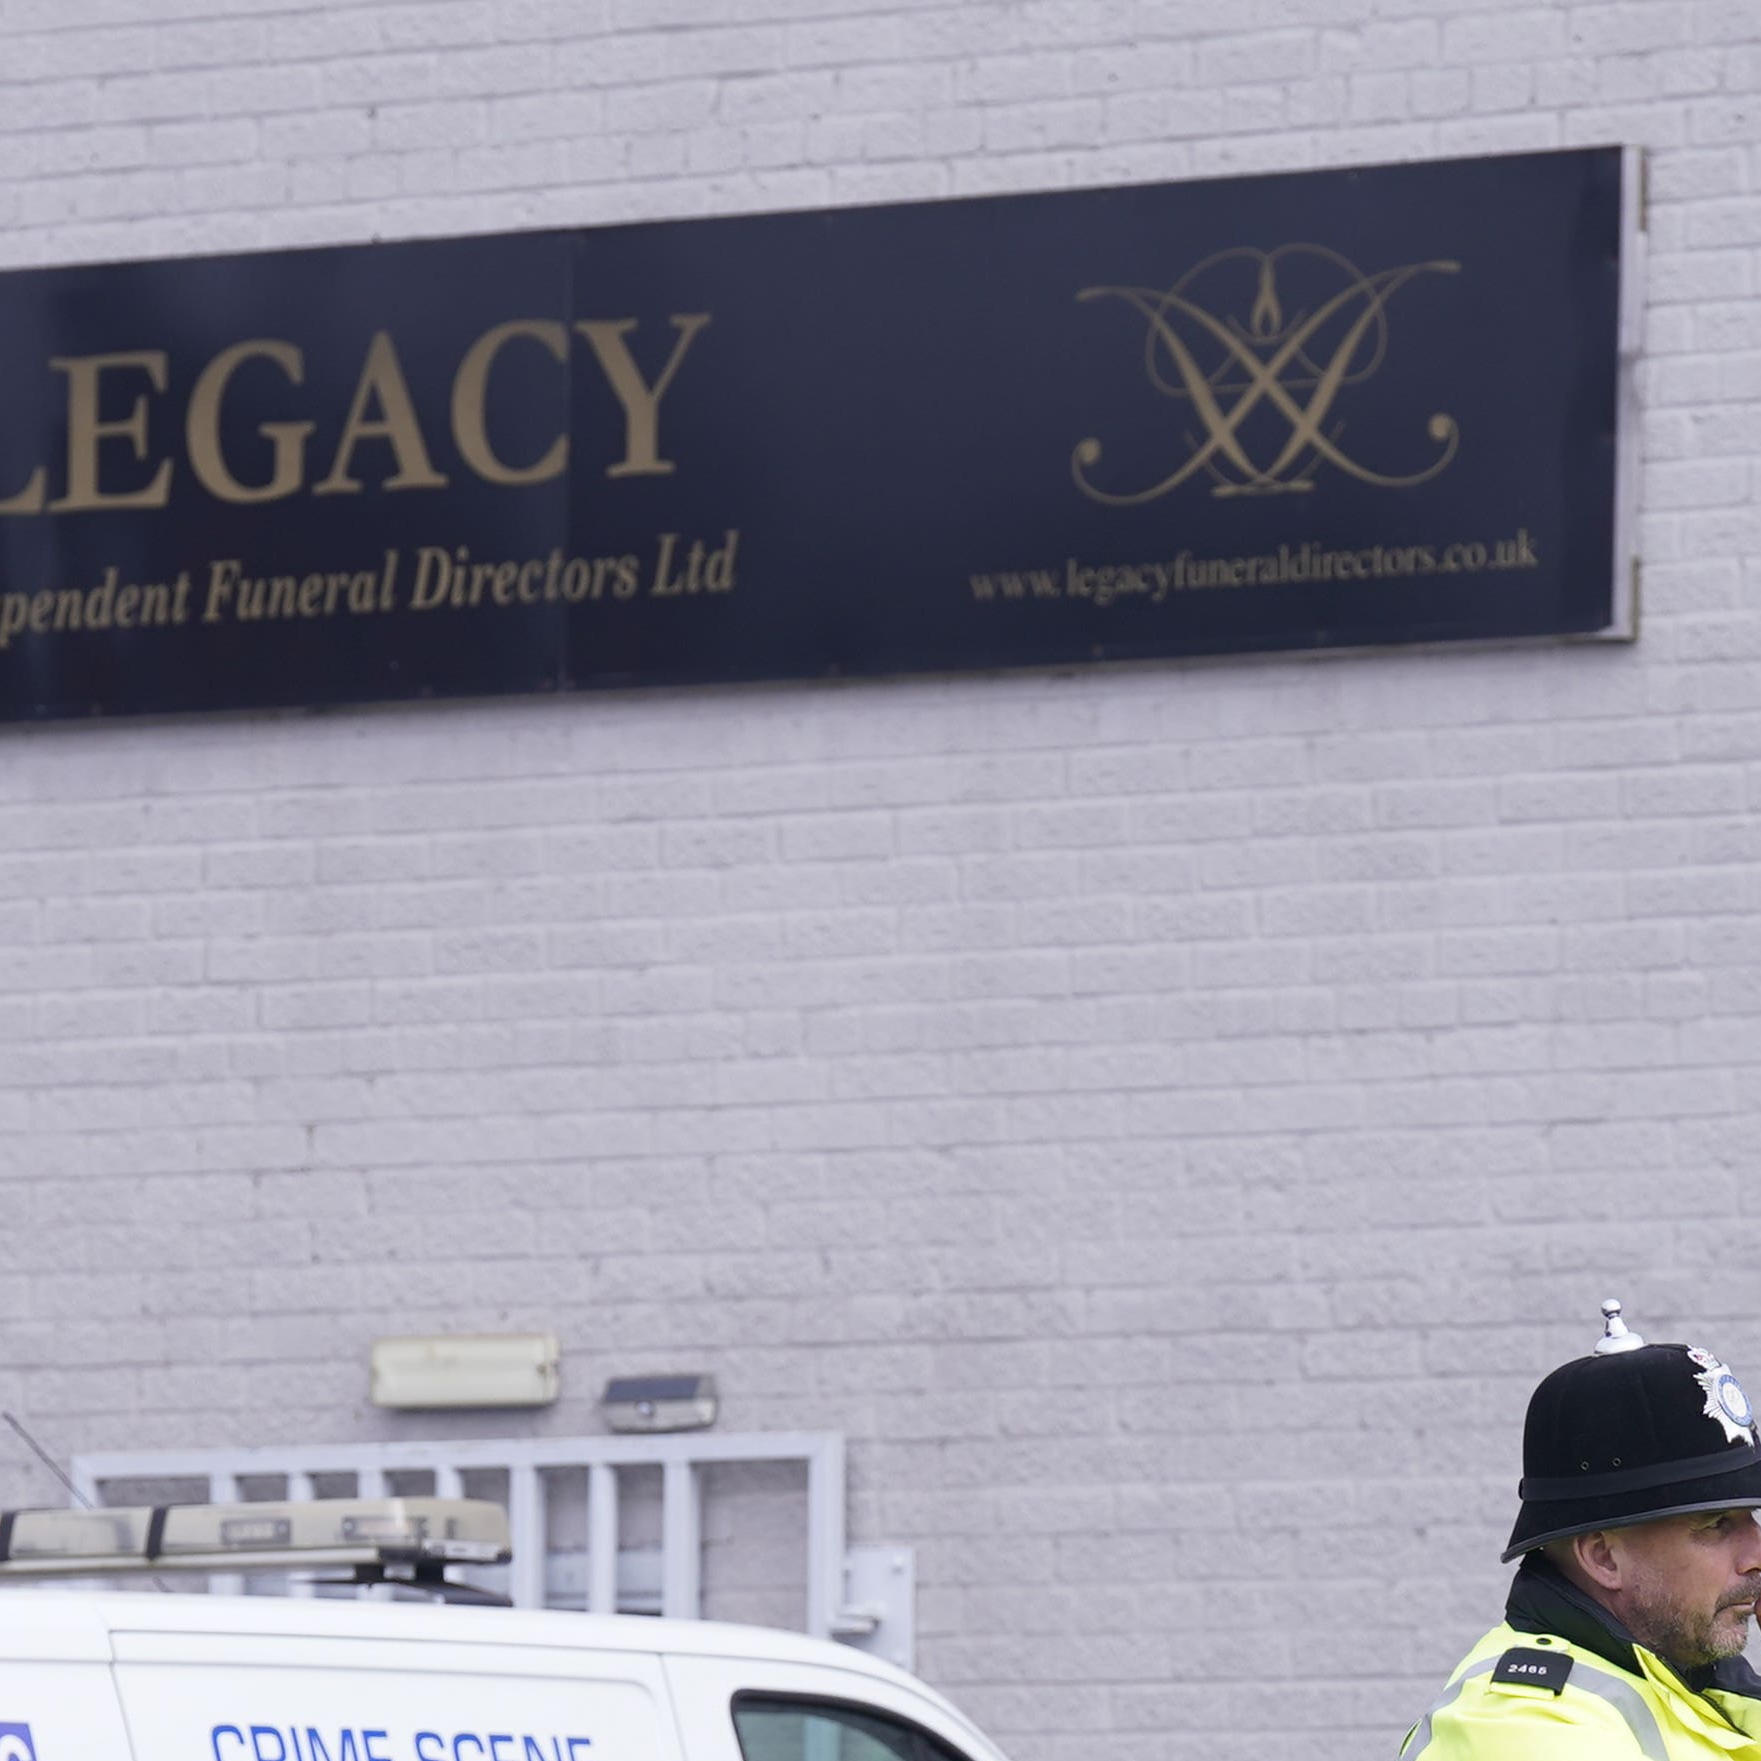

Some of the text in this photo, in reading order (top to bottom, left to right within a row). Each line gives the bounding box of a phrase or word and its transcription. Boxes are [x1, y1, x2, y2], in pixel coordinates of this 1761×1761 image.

[202, 548, 399, 626] Funeral
[410, 543, 640, 611] Directors
[651, 529, 740, 597] Ltd
